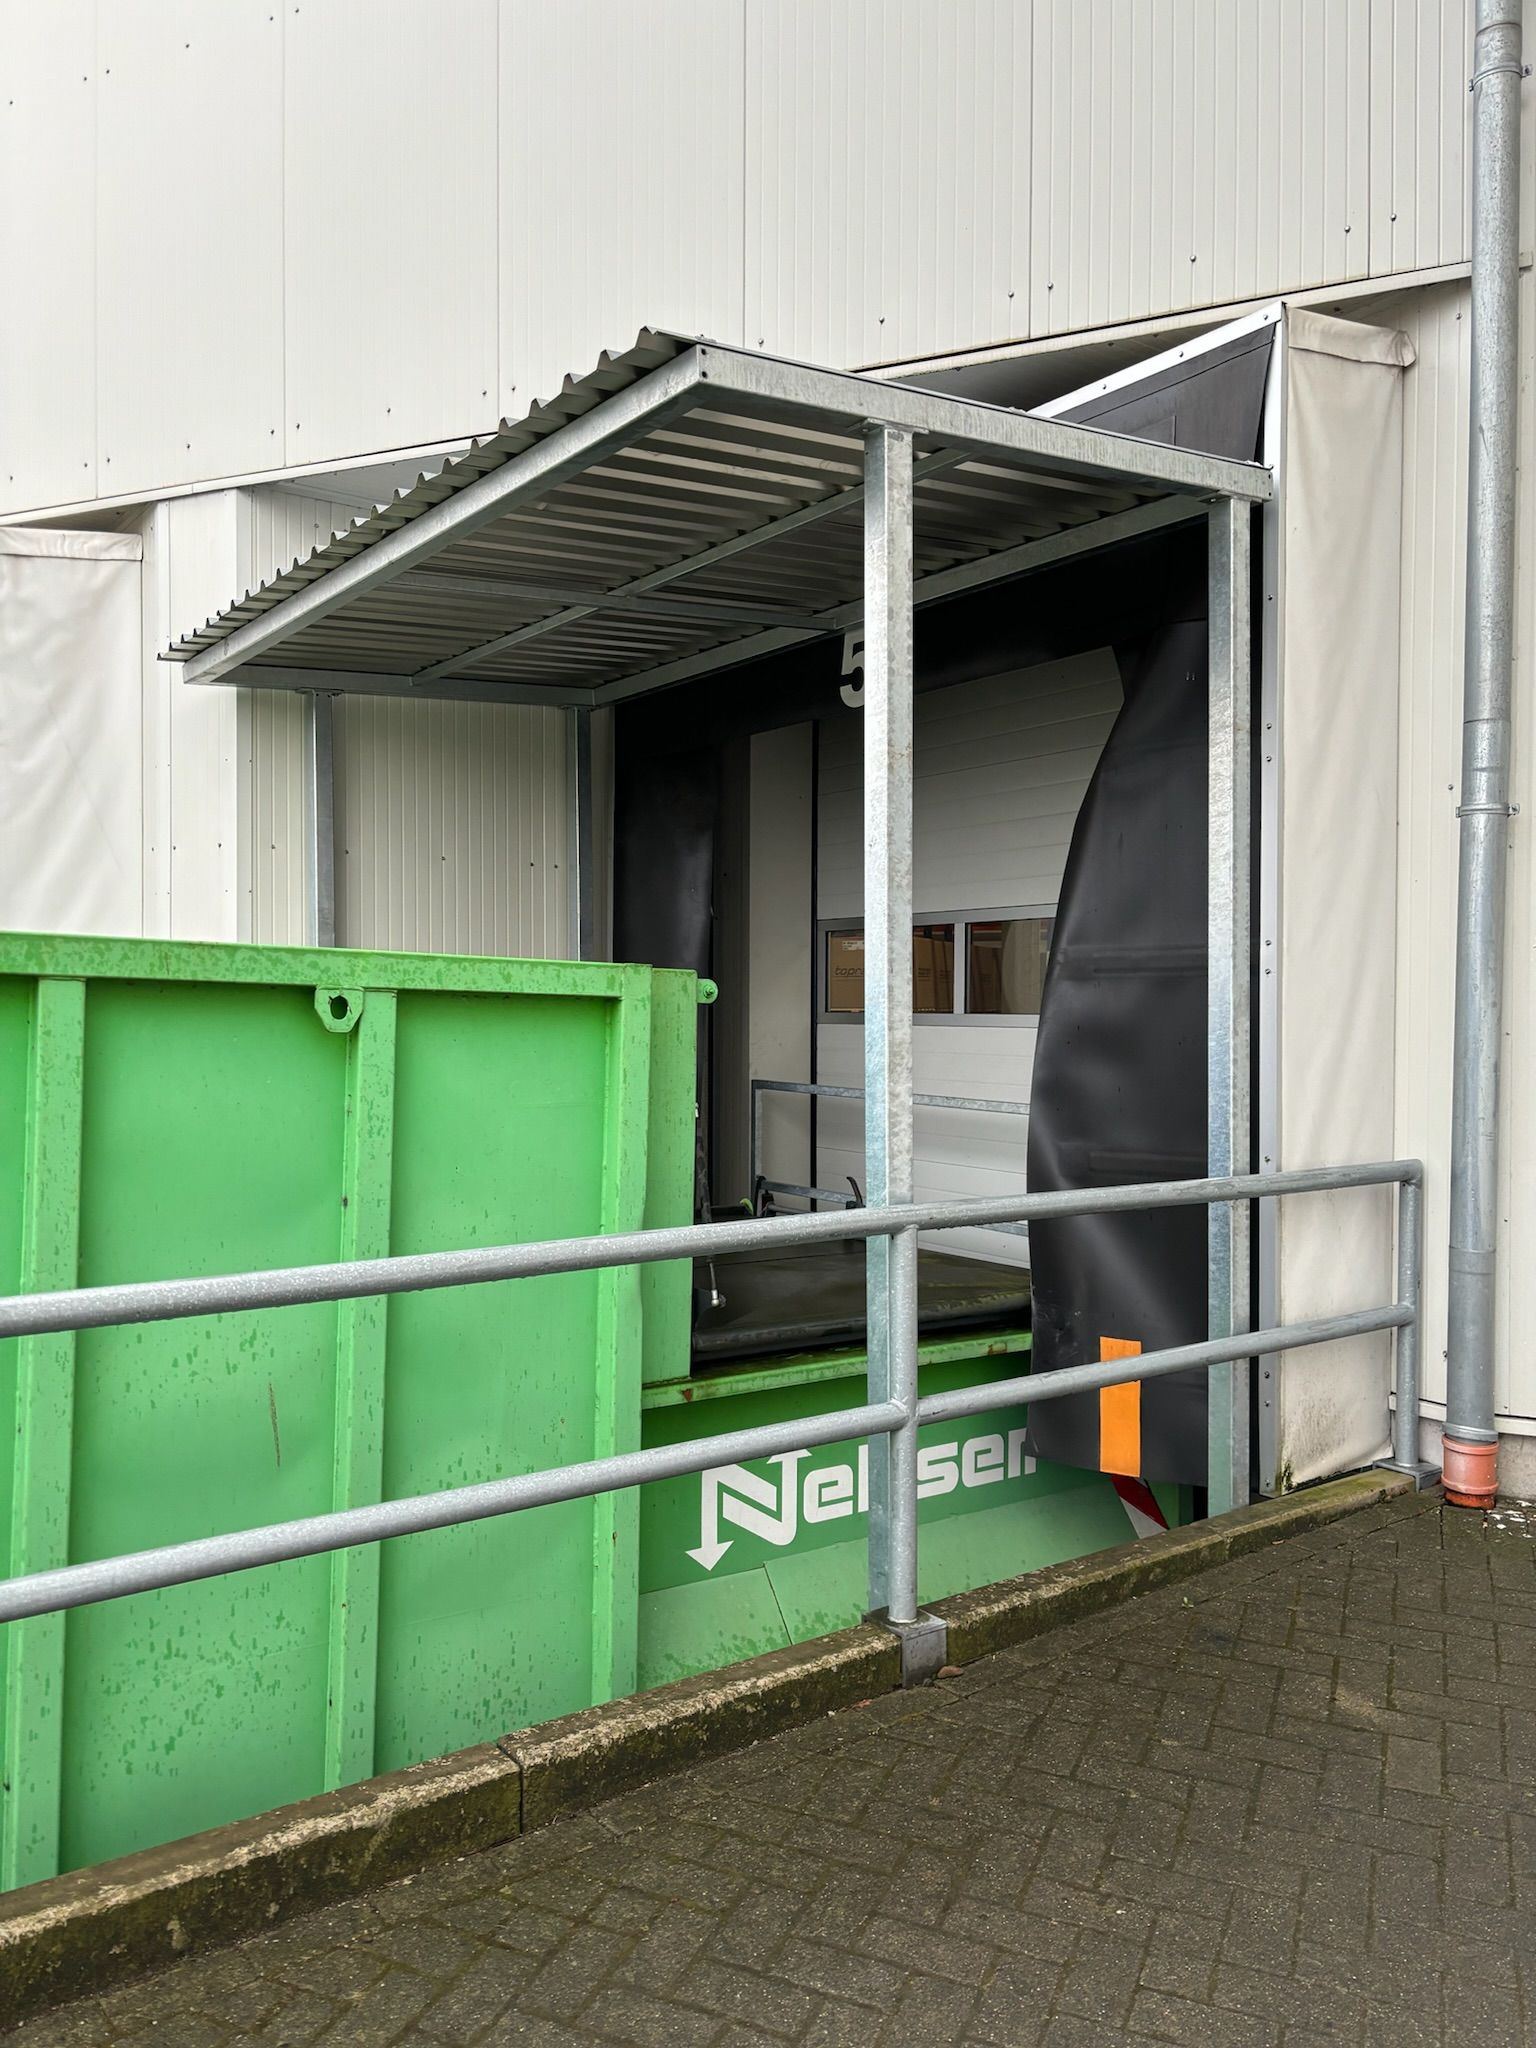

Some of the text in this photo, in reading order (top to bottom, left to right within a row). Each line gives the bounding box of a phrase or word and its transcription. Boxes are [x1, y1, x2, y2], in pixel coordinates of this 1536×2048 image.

[839, 631, 865, 709] 5
[834, 965, 865, 977] topr
[685, 1428, 1037, 1571] Nesen
